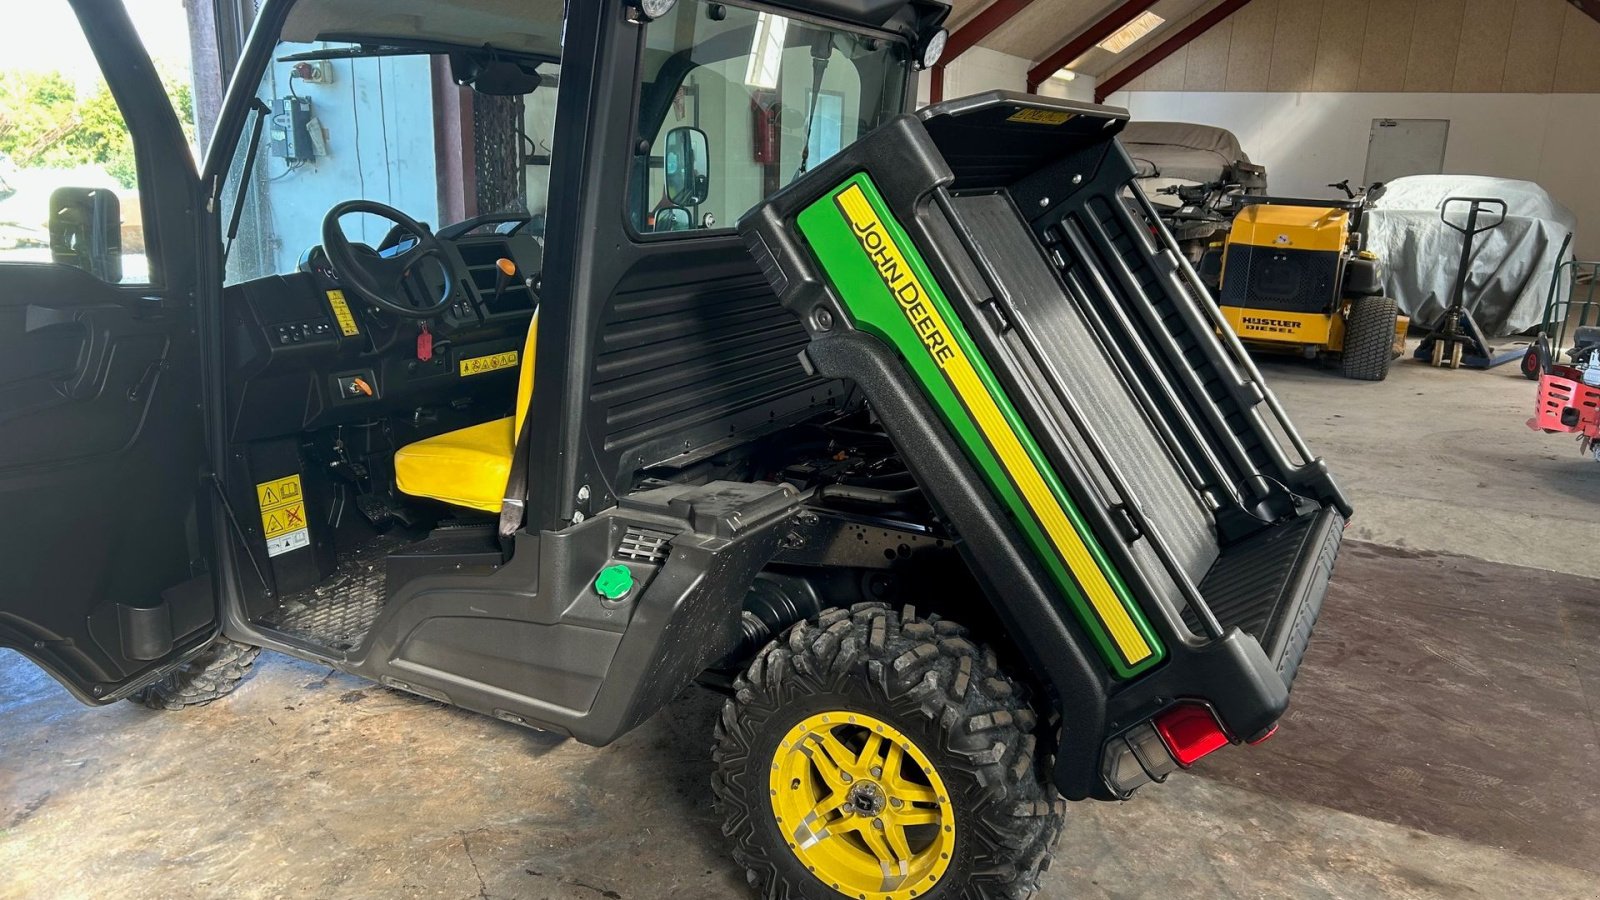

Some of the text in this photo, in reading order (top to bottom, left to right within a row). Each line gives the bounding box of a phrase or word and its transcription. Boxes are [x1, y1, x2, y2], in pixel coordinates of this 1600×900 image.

[855, 221, 955, 363] JOHN DEERE
[1242, 317, 1301, 328] HUSTLER
[1246, 325, 1295, 334] DIESEL
